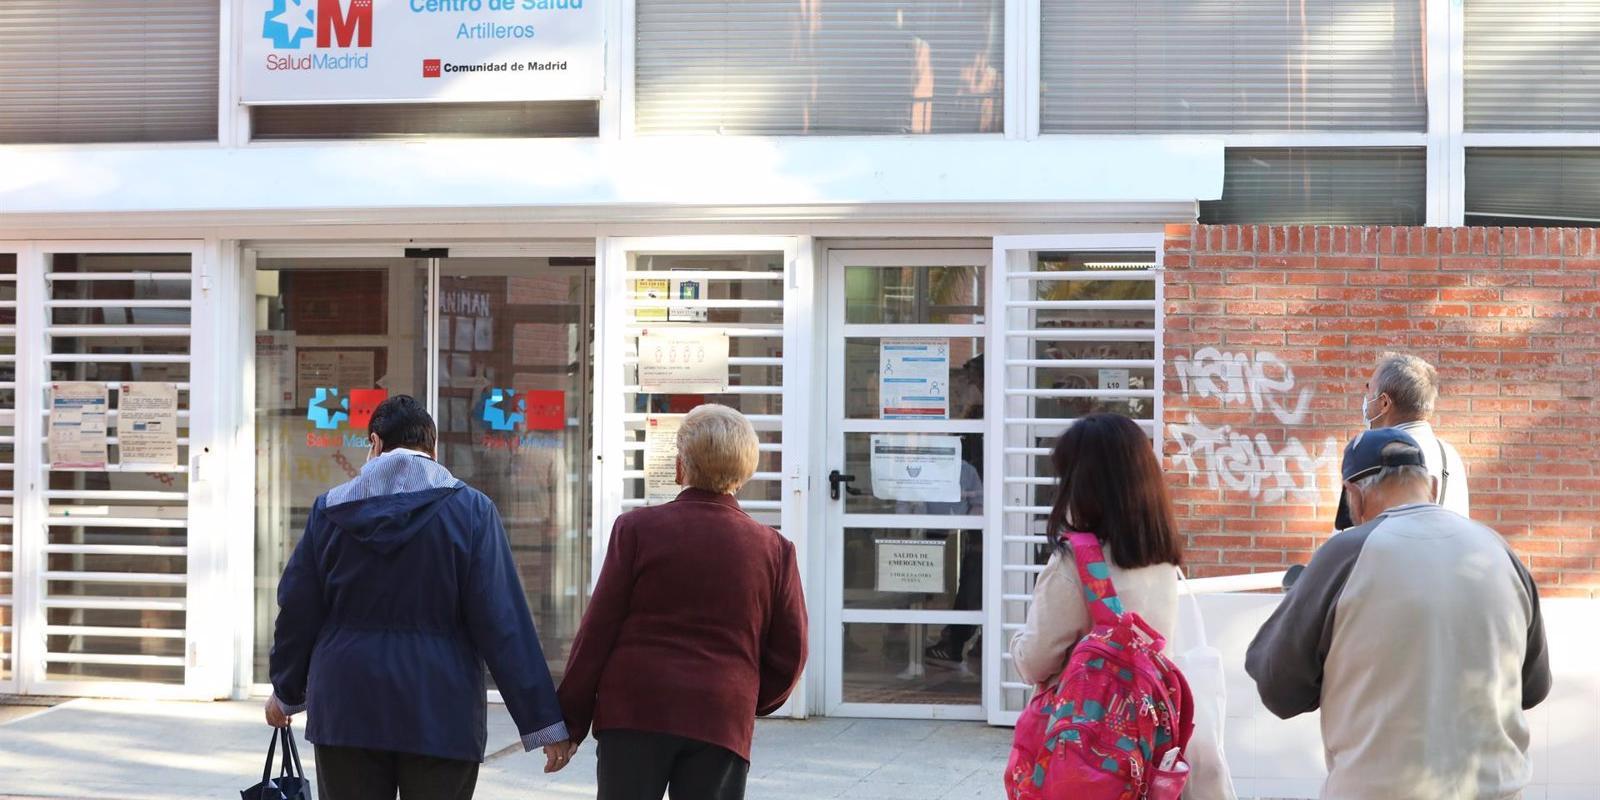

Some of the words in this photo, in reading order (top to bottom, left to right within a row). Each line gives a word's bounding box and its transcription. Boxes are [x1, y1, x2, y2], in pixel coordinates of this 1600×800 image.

[409, 0, 482, 12] Centro
[488, 0, 516, 11] de
[522, 0, 583, 10] Salud
[457, 22, 535, 39] Artilleros
[266, 53, 369, 71] SaludMadrid
[444, 62, 508, 73] Comunidad
[511, 62, 525, 72] de
[528, 61, 568, 71] Madrid
